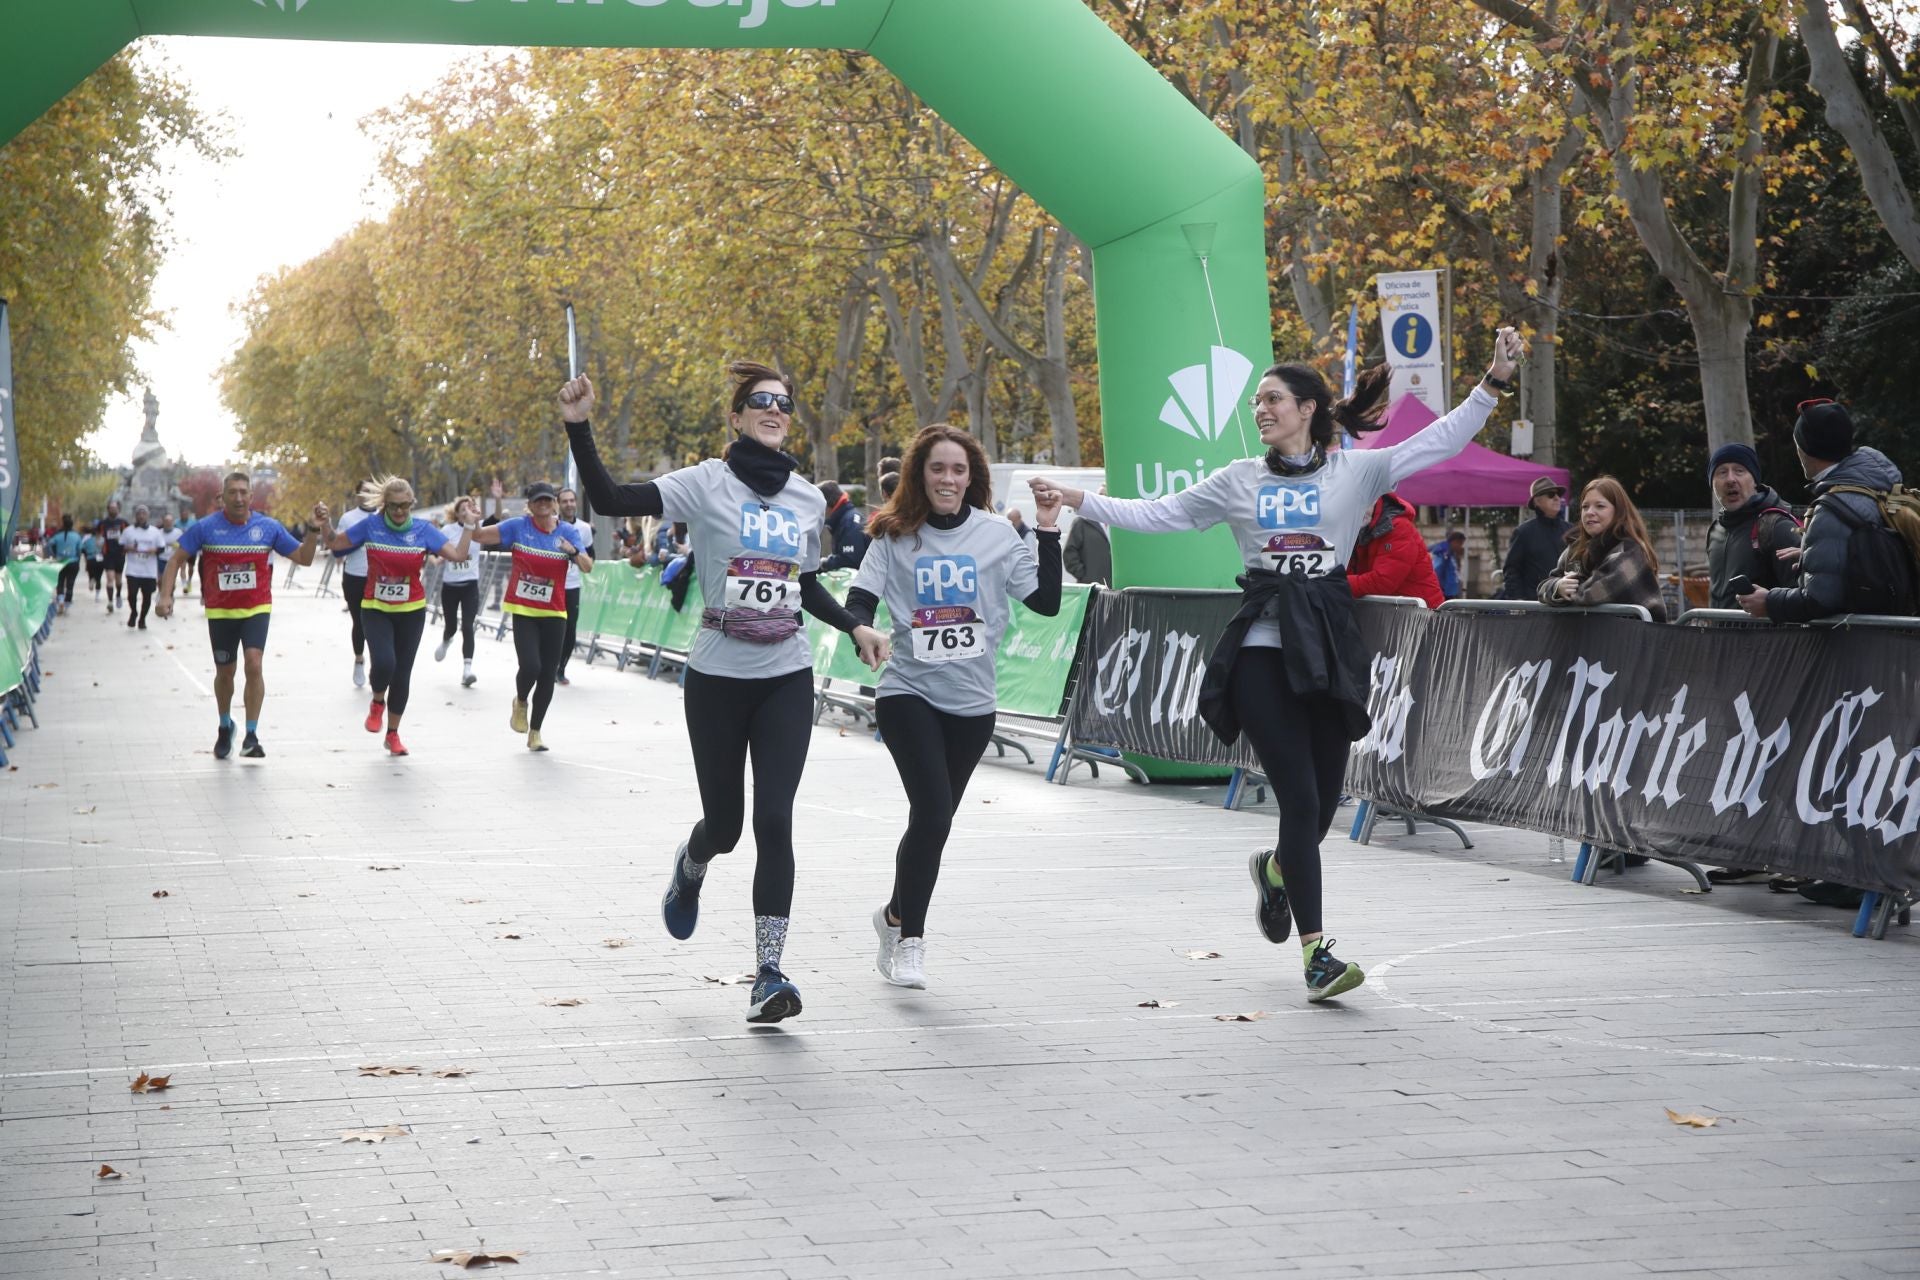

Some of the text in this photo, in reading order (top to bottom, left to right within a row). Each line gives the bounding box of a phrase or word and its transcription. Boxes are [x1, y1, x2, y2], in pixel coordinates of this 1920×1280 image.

[1385, 280, 1421, 290] Oficina de
[1260, 487, 1318, 525] PPG
[742, 508, 799, 548] PPG
[1271, 553, 1324, 575] 762
[223, 573, 250, 585] 753
[378, 585, 404, 596] 752
[522, 582, 547, 597] 754
[737, 579, 787, 603] 761
[916, 559, 975, 601] PPG
[922, 625, 976, 651] 763
[1546, 656, 1707, 810] Norte
[1709, 690, 1791, 819] de
